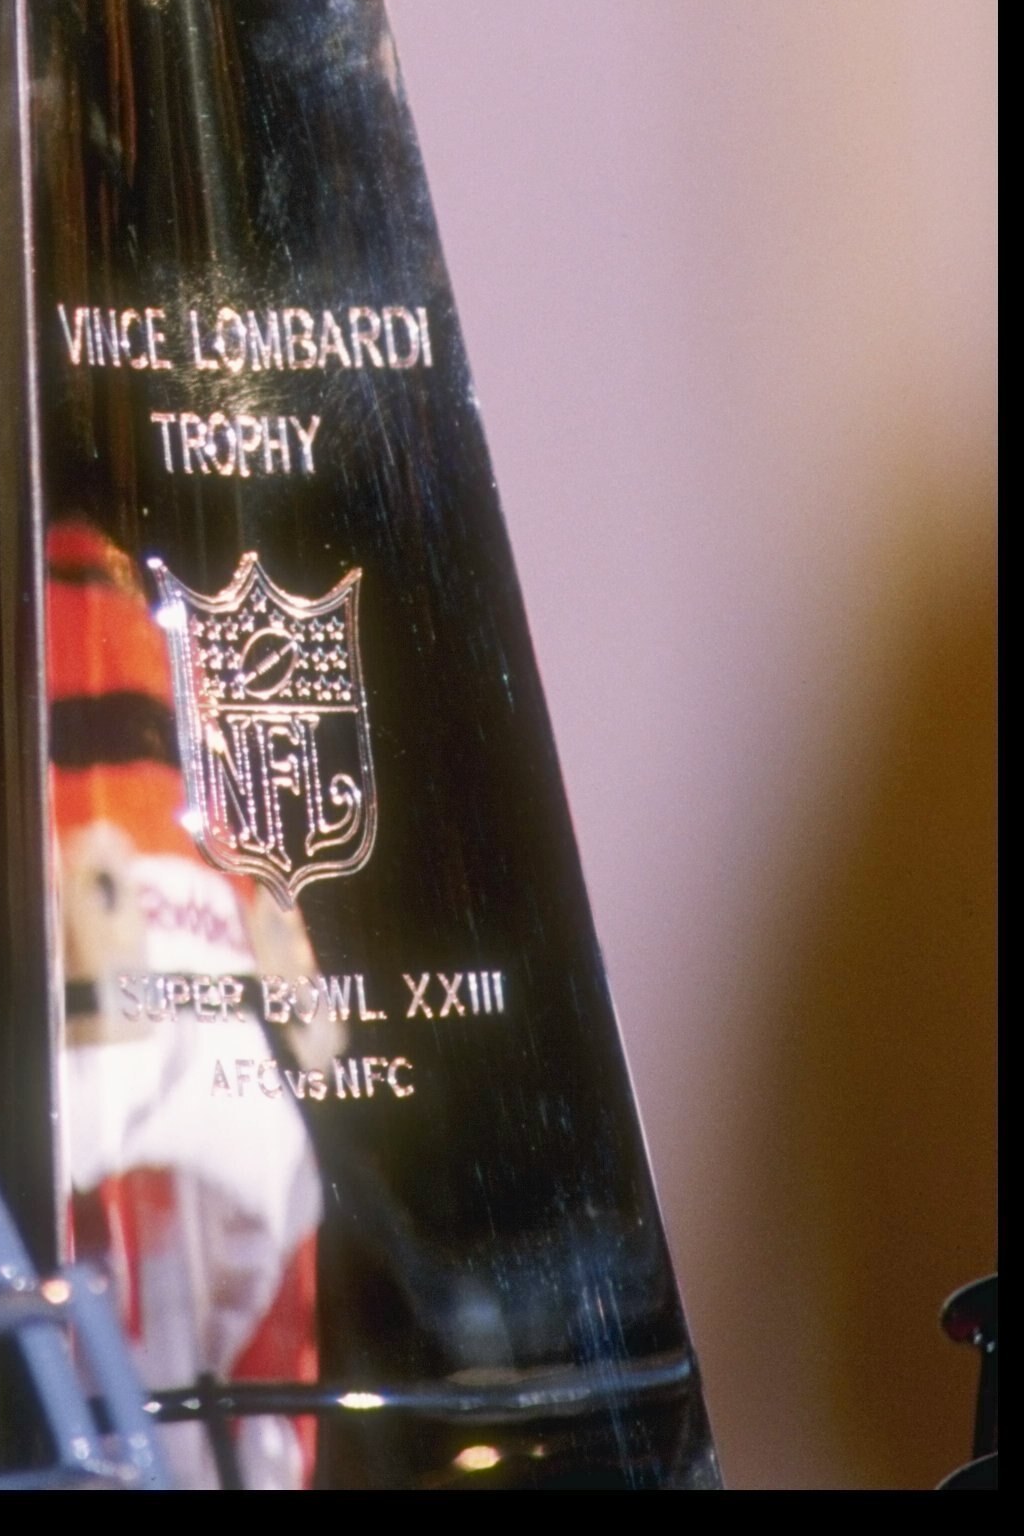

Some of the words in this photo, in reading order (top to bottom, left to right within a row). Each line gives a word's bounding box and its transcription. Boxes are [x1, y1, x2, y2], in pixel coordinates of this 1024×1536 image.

[57, 303, 172, 370] VINCE
[189, 306, 433, 372] LOMBARDI
[150, 411, 321, 478] TROPHY
[196, 711, 361, 872] NFL
[119, 974, 247, 1024] SUPER
[261, 972, 388, 1024] BOWL
[402, 970, 506, 1019] XXIII
[210, 1056, 283, 1101] AFC
[283, 1068, 327, 1102] vs
[334, 1056, 415, 1100] NFC
